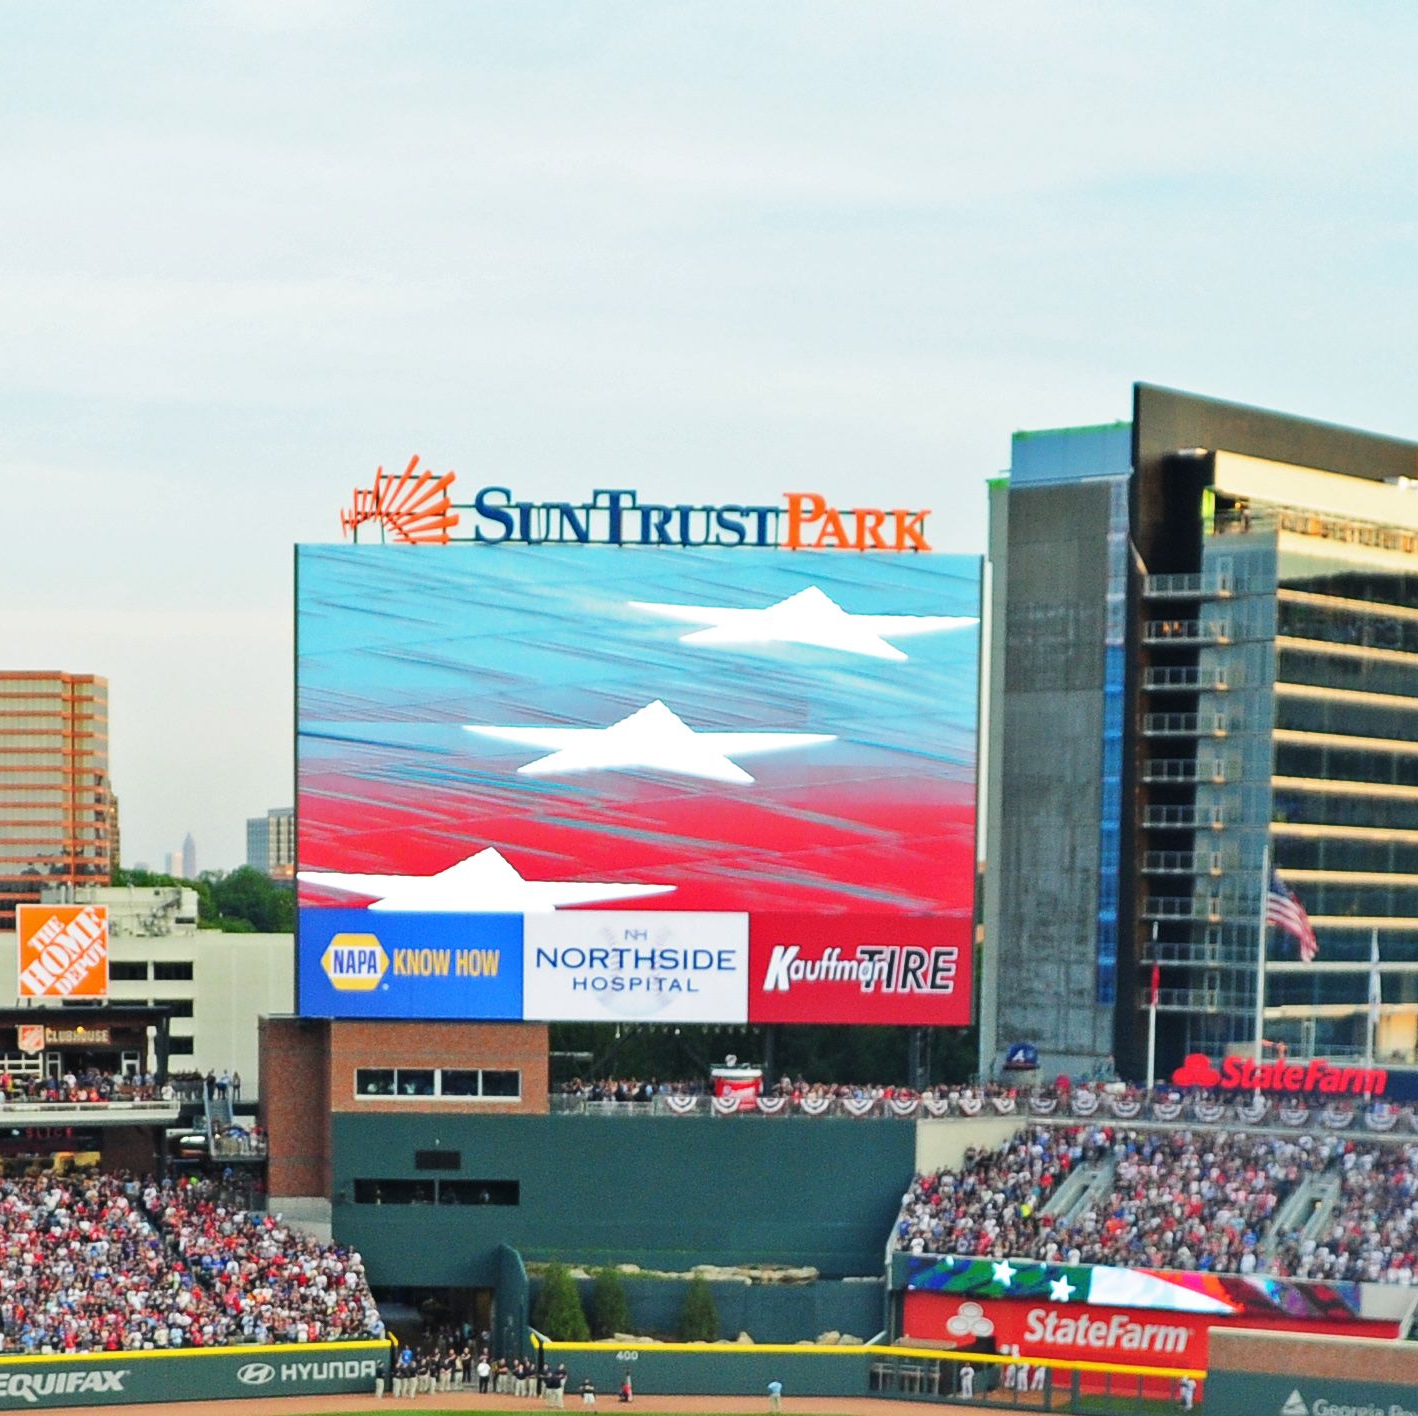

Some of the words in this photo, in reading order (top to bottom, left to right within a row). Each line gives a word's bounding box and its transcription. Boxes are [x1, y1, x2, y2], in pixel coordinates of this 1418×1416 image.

[782, 492, 931, 552] PARK
[21, 906, 108, 995] HOME
[27, 914, 66, 952] THE
[54, 938, 107, 995] DEPOT
[333, 949, 378, 975] NAPA
[392, 948, 451, 976] KNOW
[455, 948, 501, 977] HOW
[536, 947, 737, 971] NORTHSIDE
[762, 944, 890, 992] Kauffman
[857, 945, 959, 995] TIRE
[572, 975, 700, 993] HOSPITAL
[45, 1028, 110, 1044] CLUBHOUSE
[1219, 1055, 1388, 1095] StateFarm
[1024, 1307, 1190, 1353] StateFarm
[615, 1351, 639, 1362] 400
